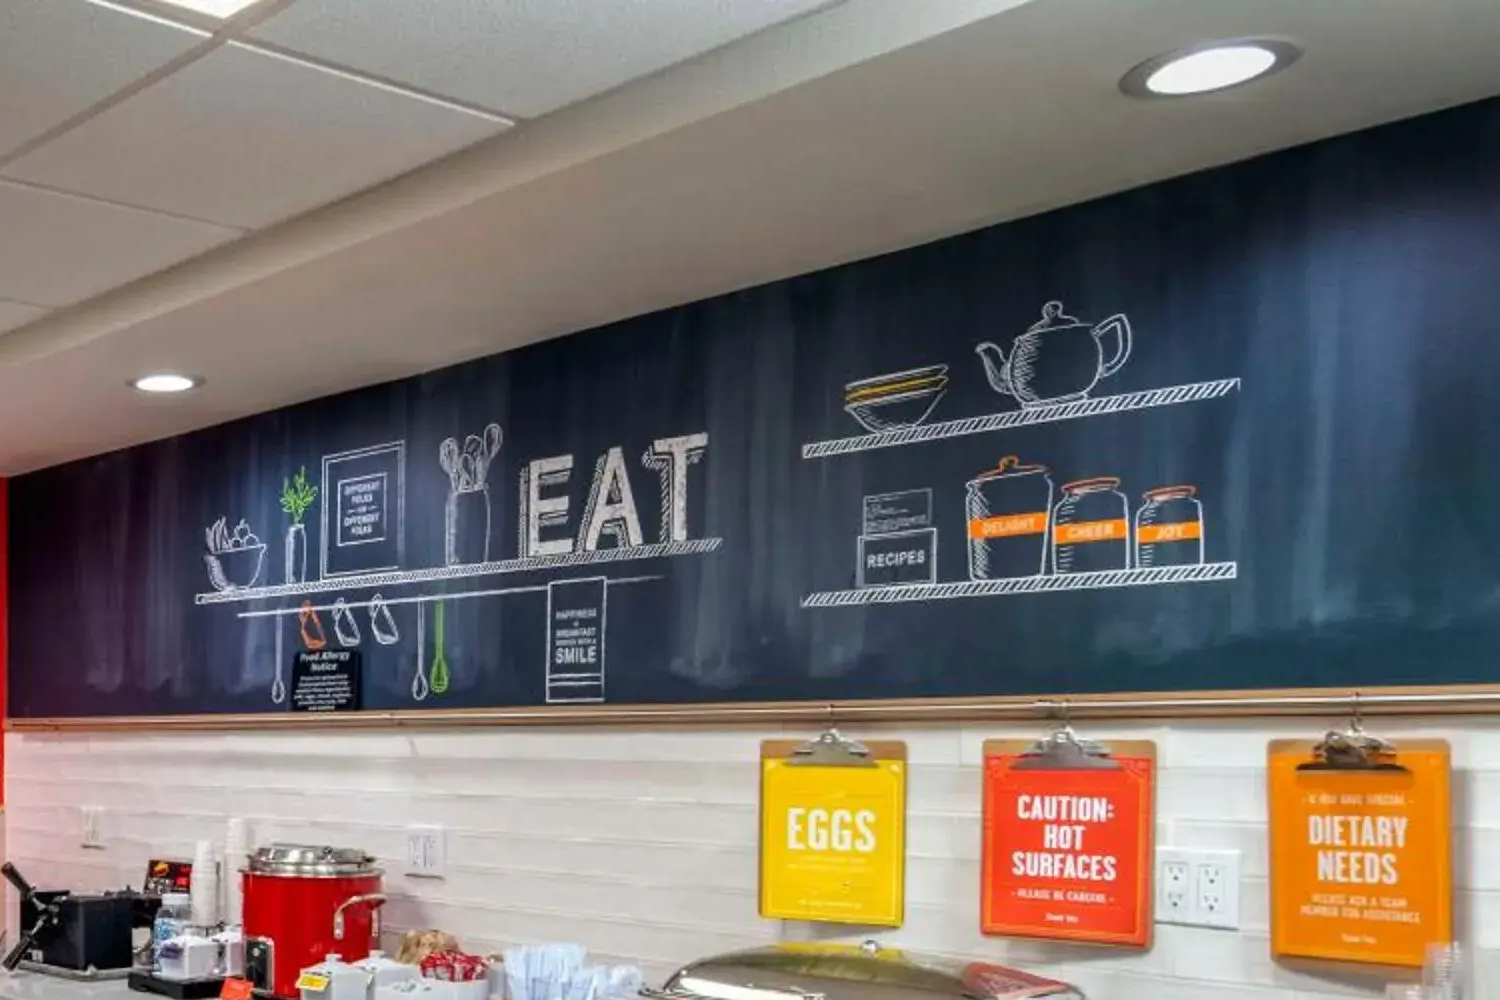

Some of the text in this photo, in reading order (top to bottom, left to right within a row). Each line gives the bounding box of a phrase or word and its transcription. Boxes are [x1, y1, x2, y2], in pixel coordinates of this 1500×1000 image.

[519, 432, 708, 558] EAT
[1156, 525, 1183, 538] JOY
[867, 550, 925, 568] RECIPES
[556, 646, 596, 664] SMILE
[1017, 795, 1115, 822] CAUTION:
[787, 807, 876, 853] EGGS
[1043, 824, 1086, 851] HOT
[1308, 815, 1408, 848] DIETARY
[1012, 851, 1117, 881] SURFACES
[1318, 851, 1398, 884] NEEDS
